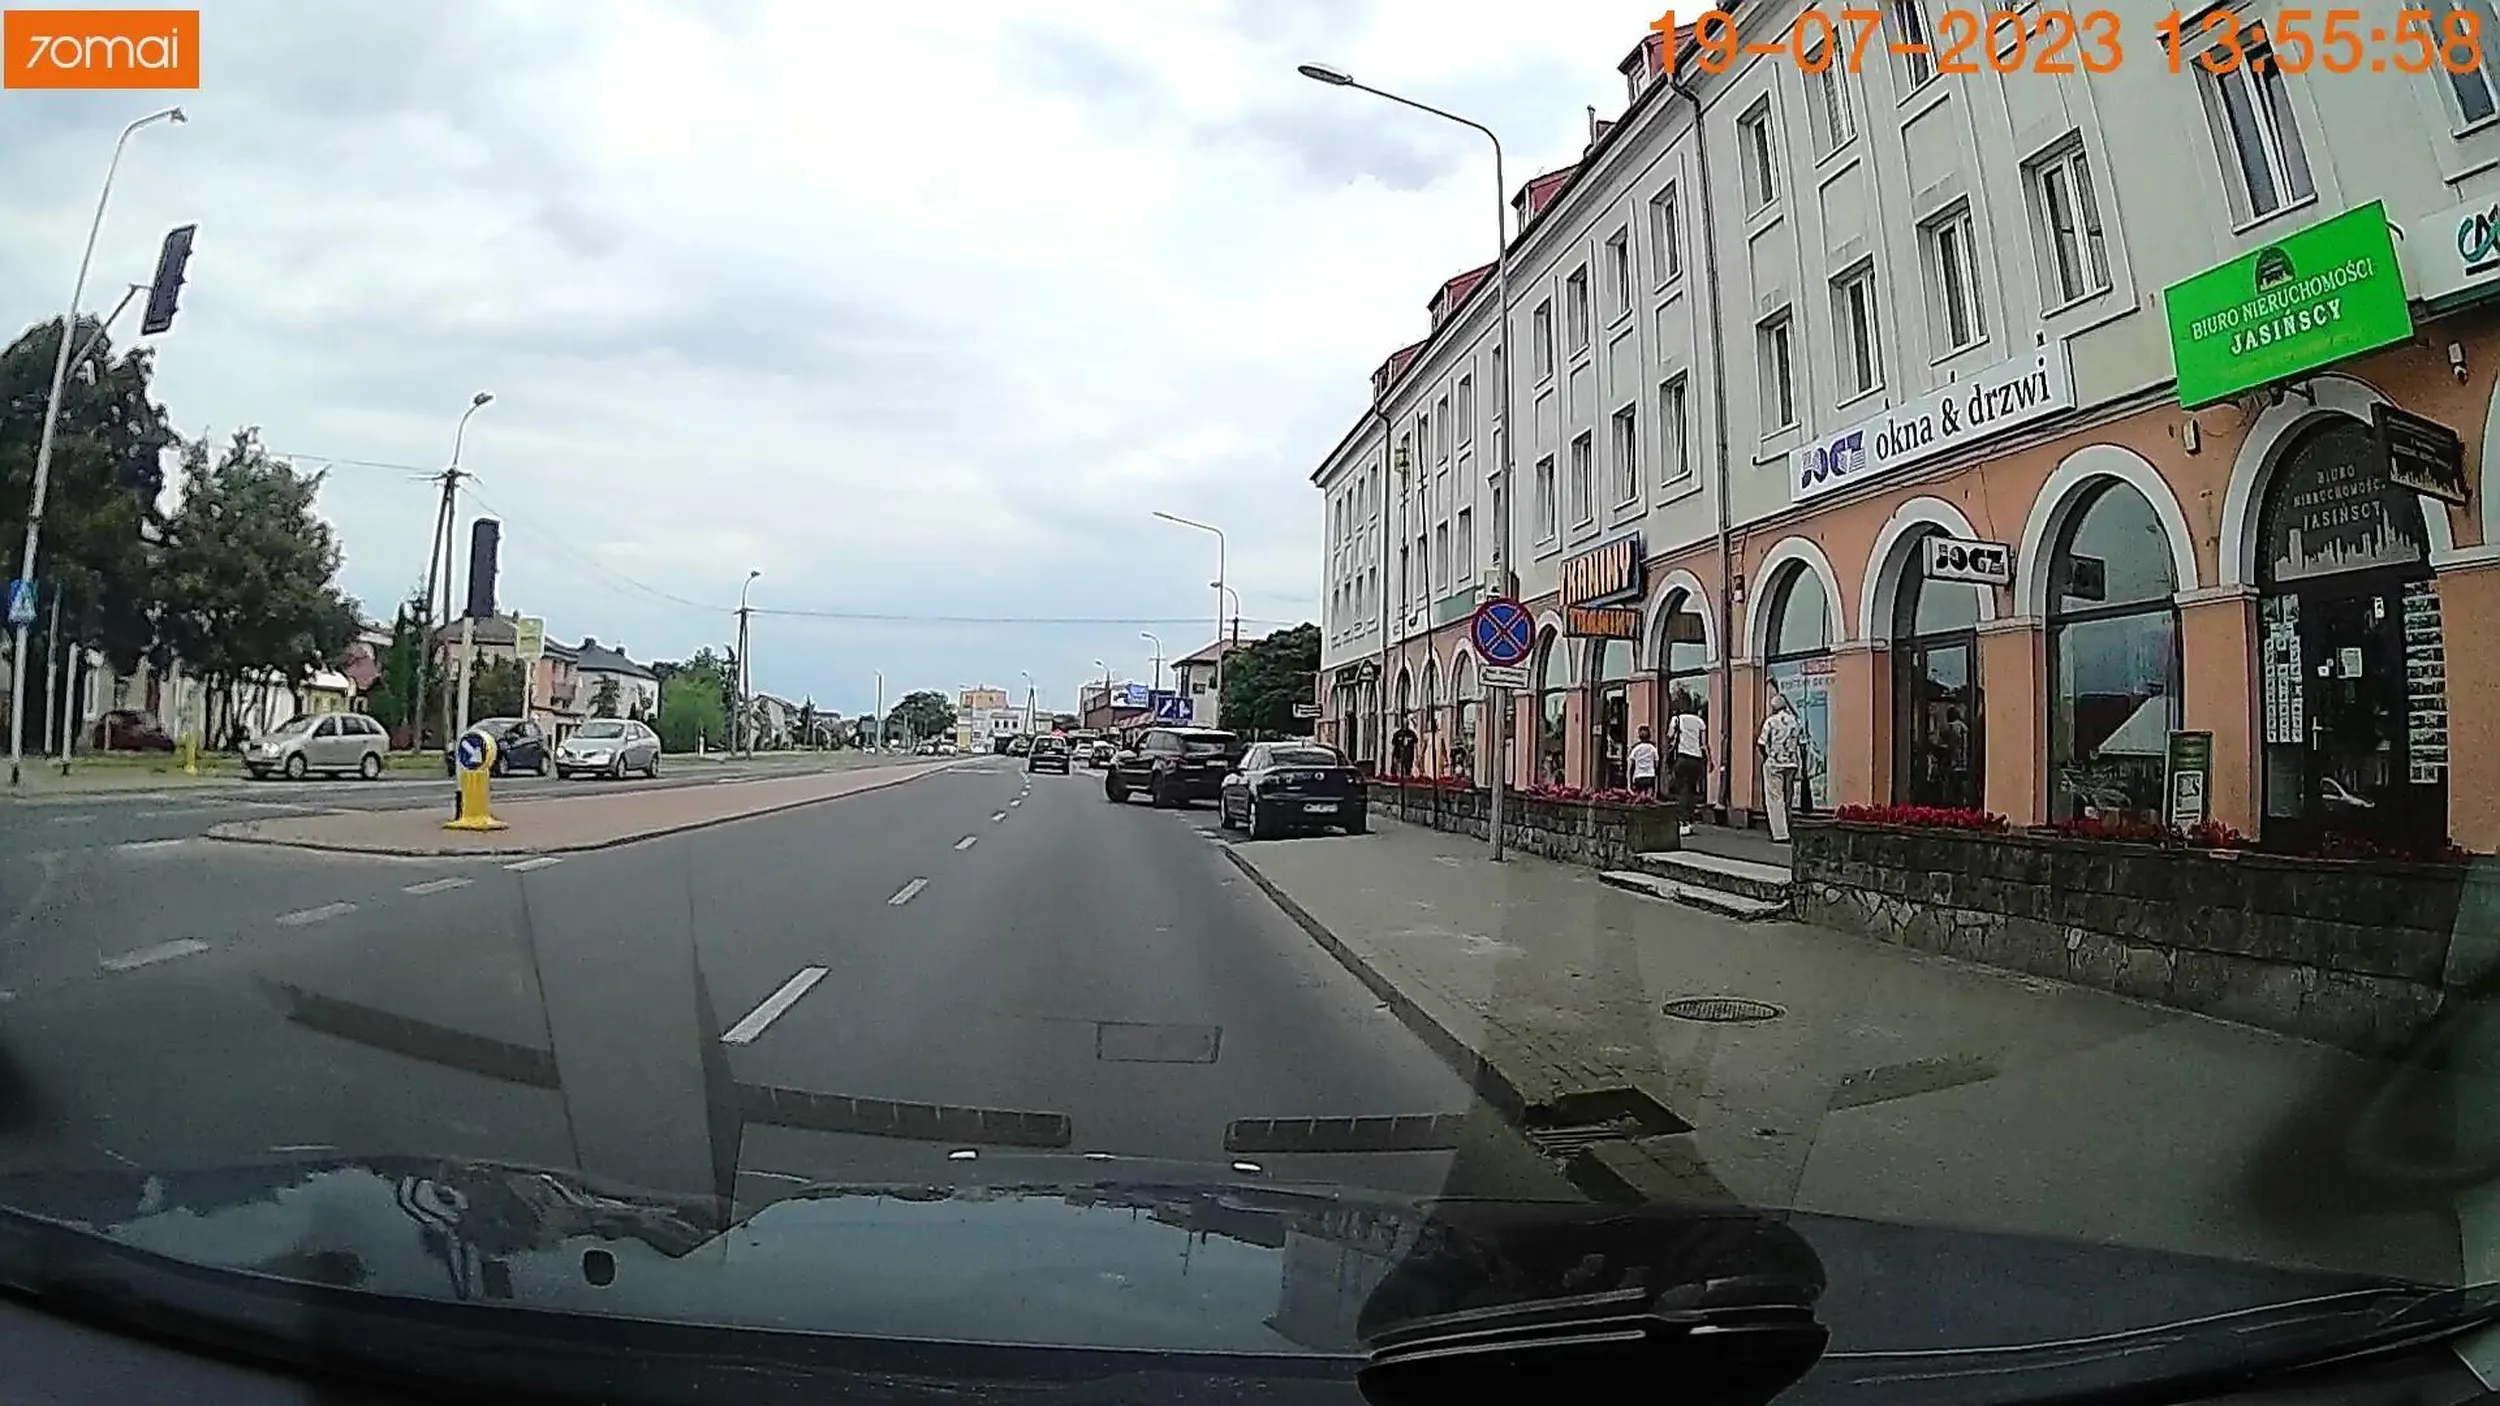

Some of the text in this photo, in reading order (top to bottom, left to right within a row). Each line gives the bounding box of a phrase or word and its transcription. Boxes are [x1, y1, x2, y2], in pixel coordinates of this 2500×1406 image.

[2191, 257, 2375, 341] BIURO NIERUCHOMOŚCI
[2231, 298, 2342, 355] JASIŃSCY
[1875, 416, 1934, 461] okna
[1941, 397, 1961, 437] &
[1968, 357, 2051, 426] drzwi
